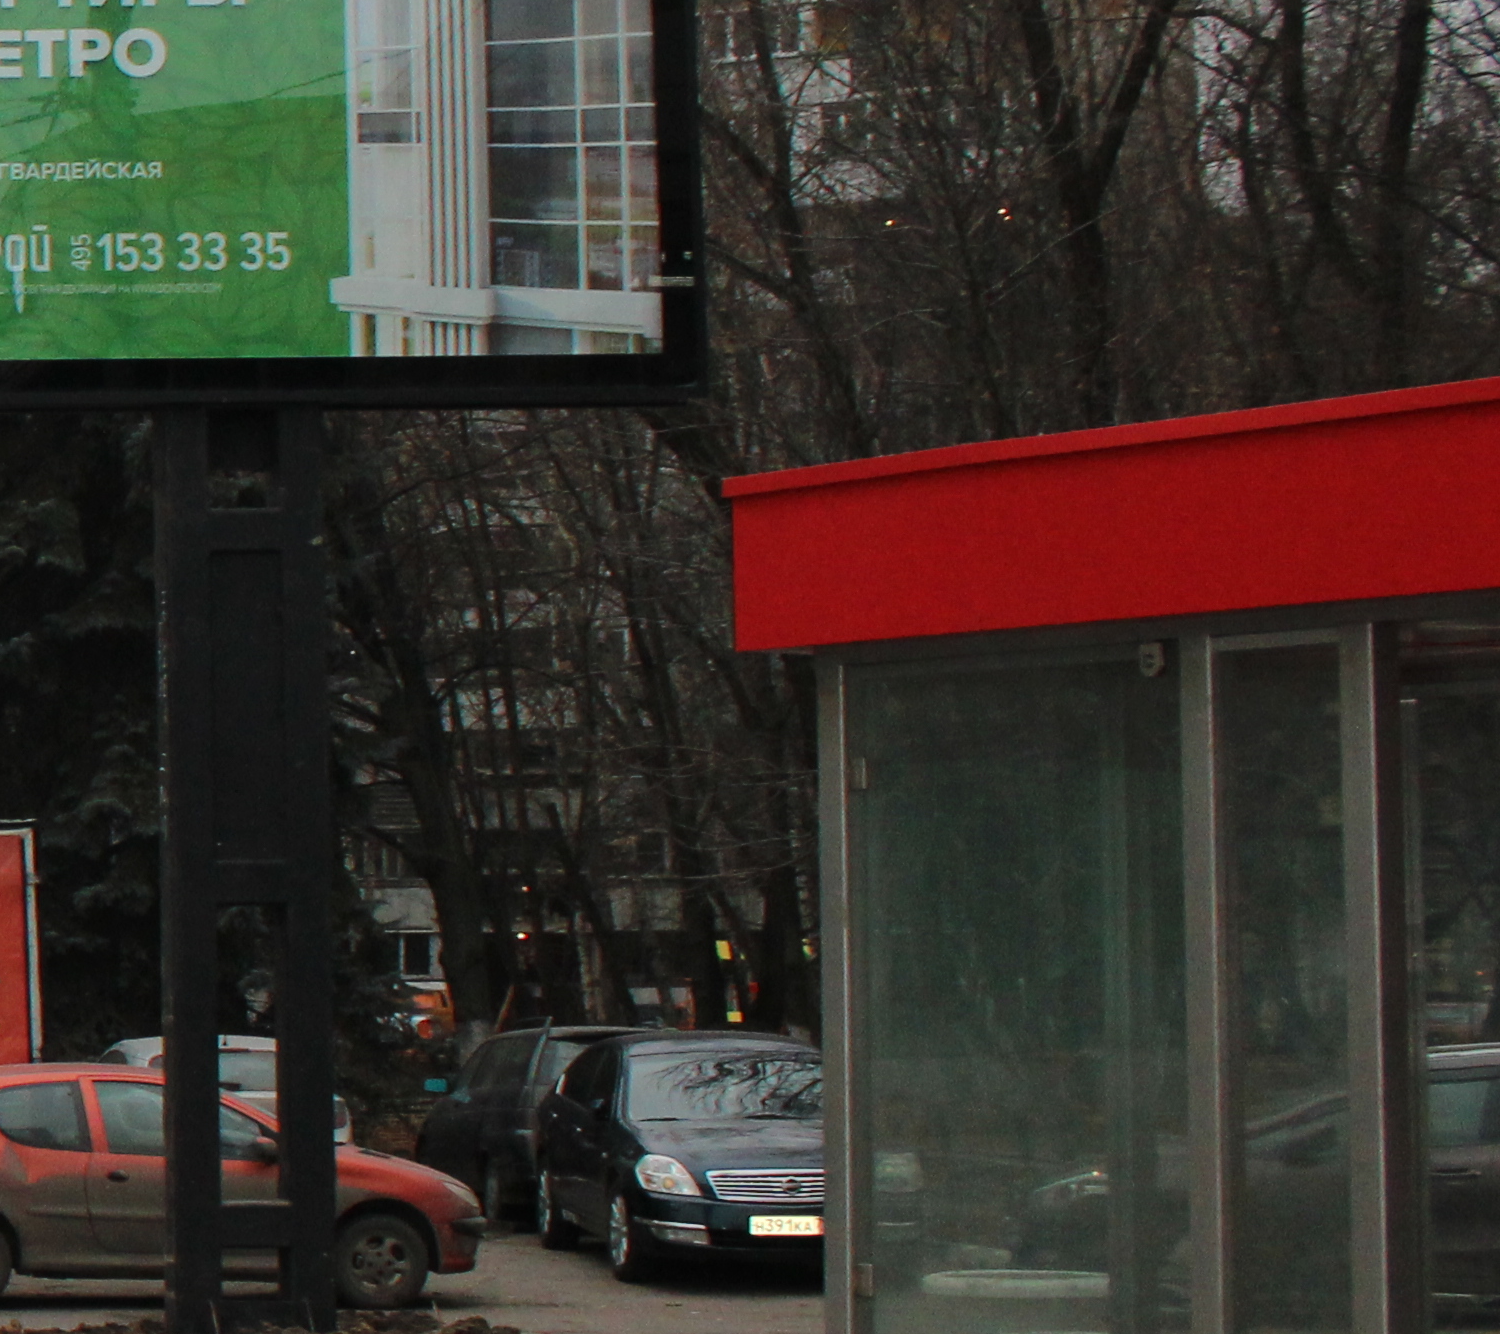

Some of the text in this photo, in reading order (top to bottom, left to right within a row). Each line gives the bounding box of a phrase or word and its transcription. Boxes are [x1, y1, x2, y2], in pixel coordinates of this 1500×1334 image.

[70, 230, 292, 273] 495 153 33 35
